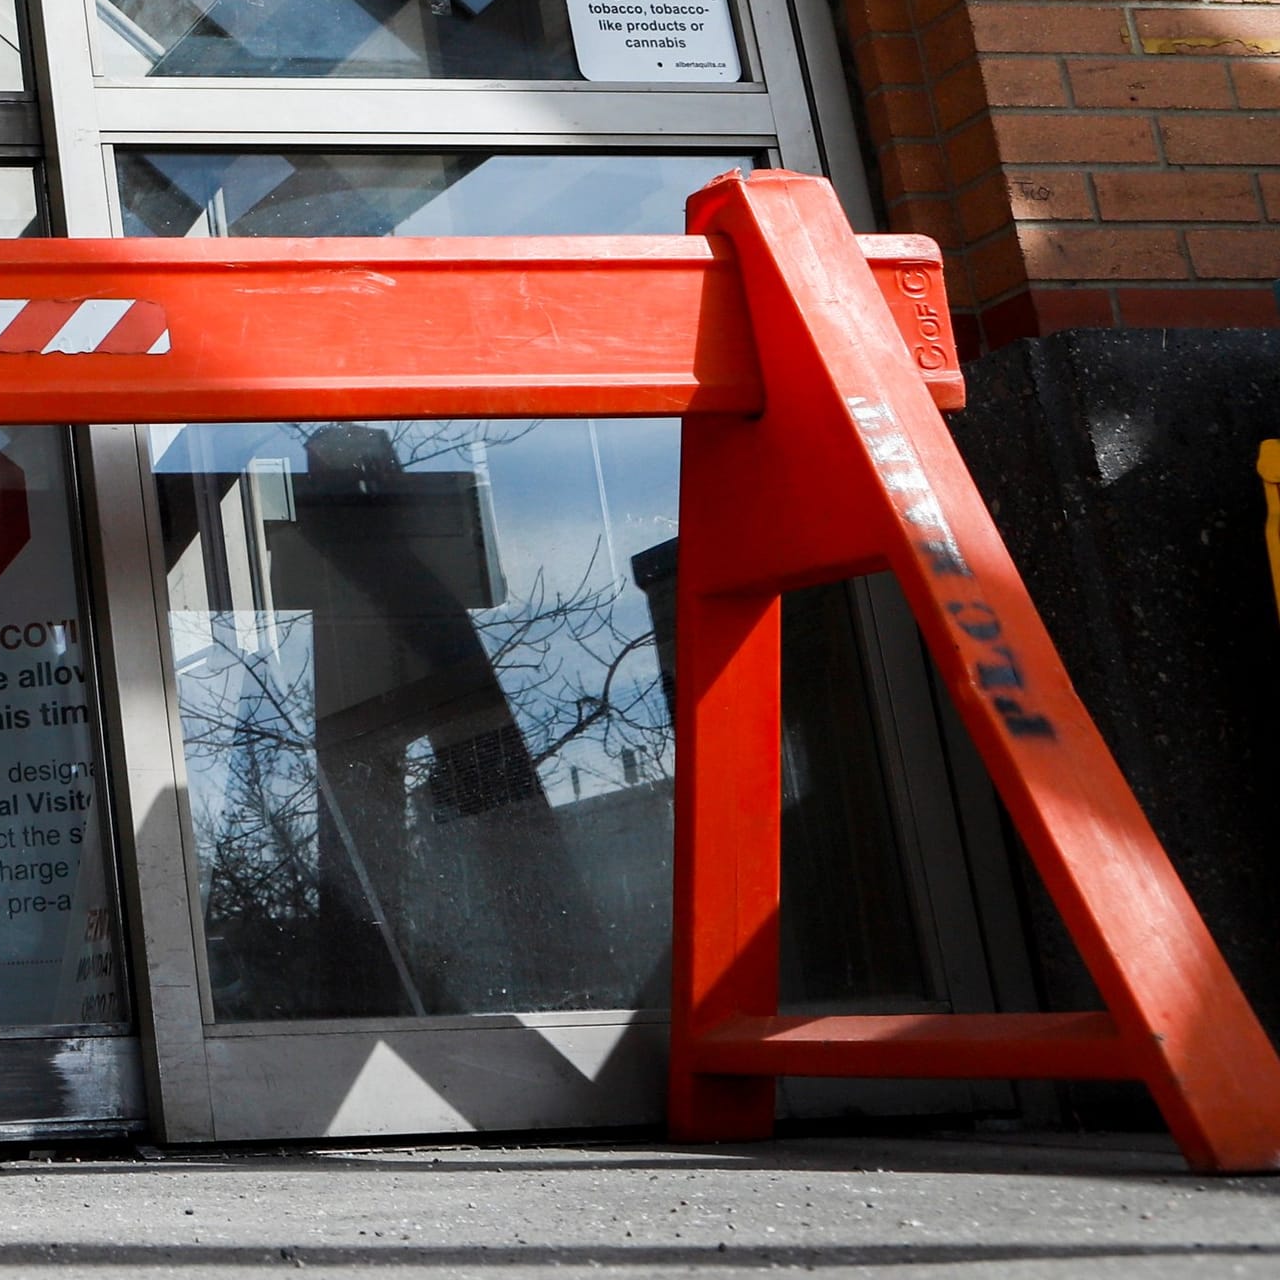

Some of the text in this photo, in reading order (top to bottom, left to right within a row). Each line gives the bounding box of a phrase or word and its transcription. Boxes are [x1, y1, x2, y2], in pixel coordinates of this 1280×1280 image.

[588, 3, 709, 16] tobacco, tobacco-
[598, 20, 704, 33] like products or
[625, 37, 687, 48] cannabis
[675, 61, 726, 69] albertaquits.ca
[947, 602, 1056, 740] PLC
